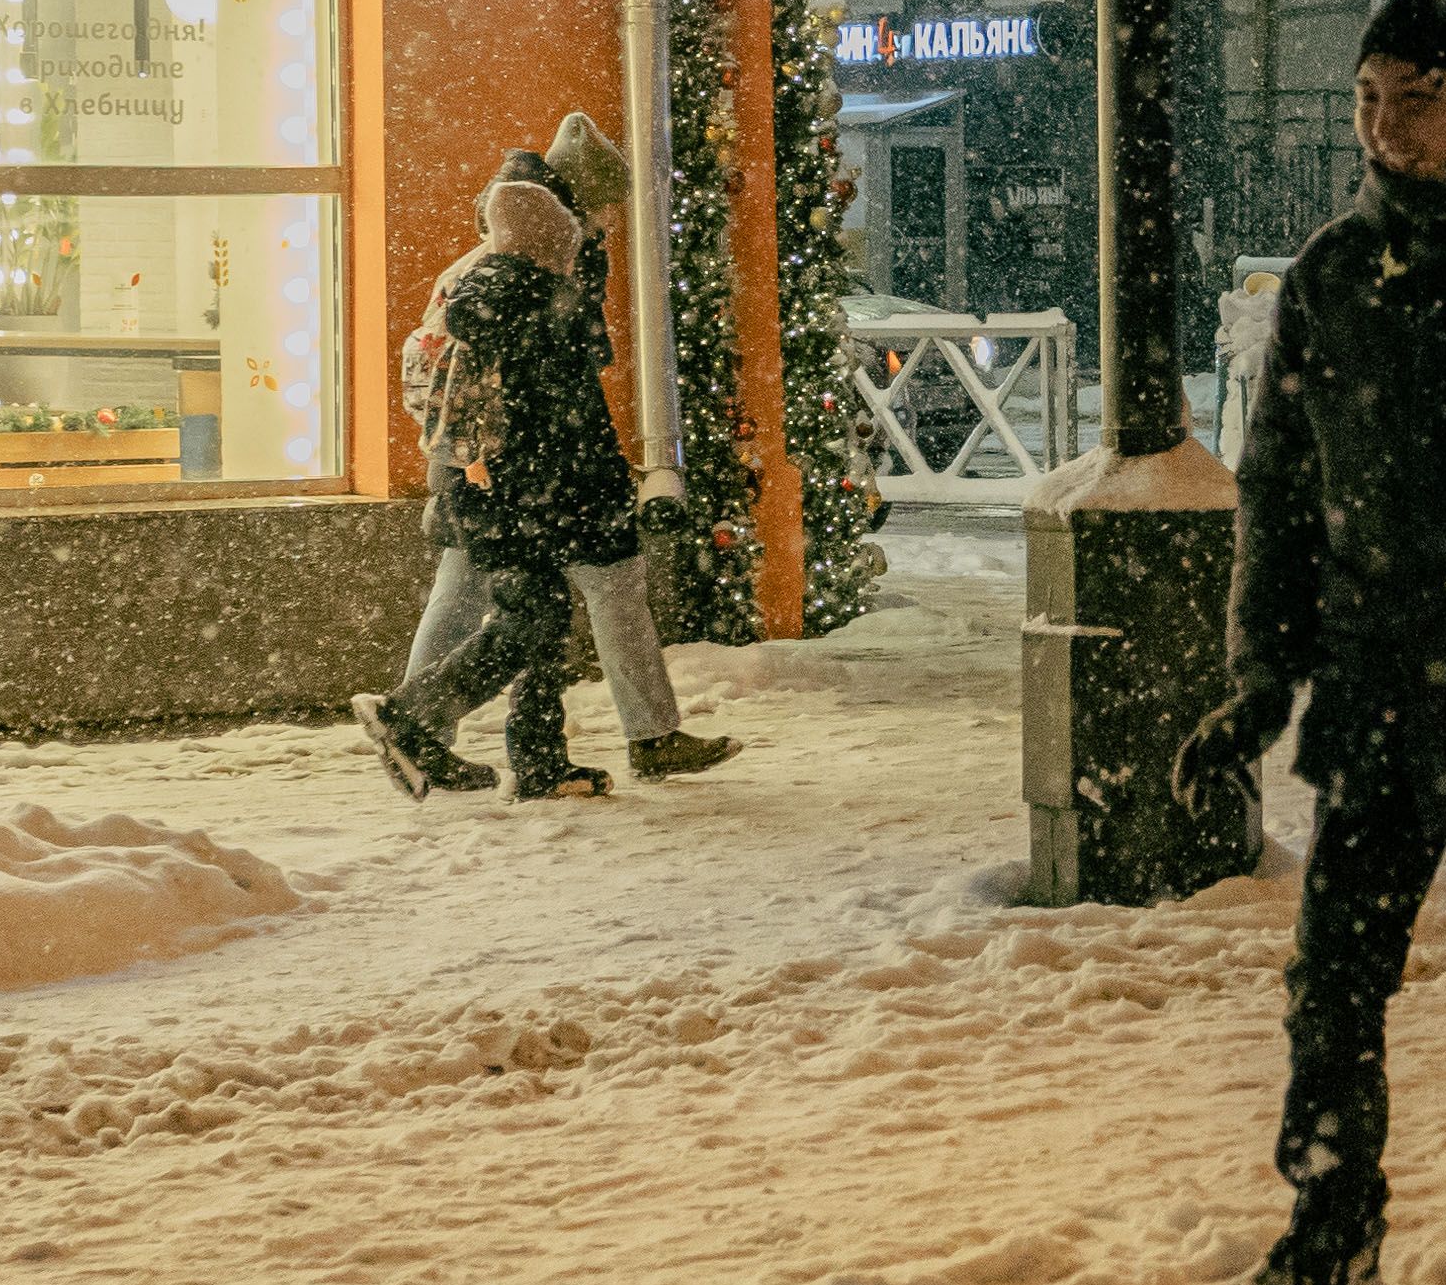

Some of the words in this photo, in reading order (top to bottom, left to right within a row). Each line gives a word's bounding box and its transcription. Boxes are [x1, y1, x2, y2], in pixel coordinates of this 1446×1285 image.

[148, 18, 205, 42] дня!
[31, 54, 184, 83] риходите
[44, 92, 185, 125] Хлебницу
